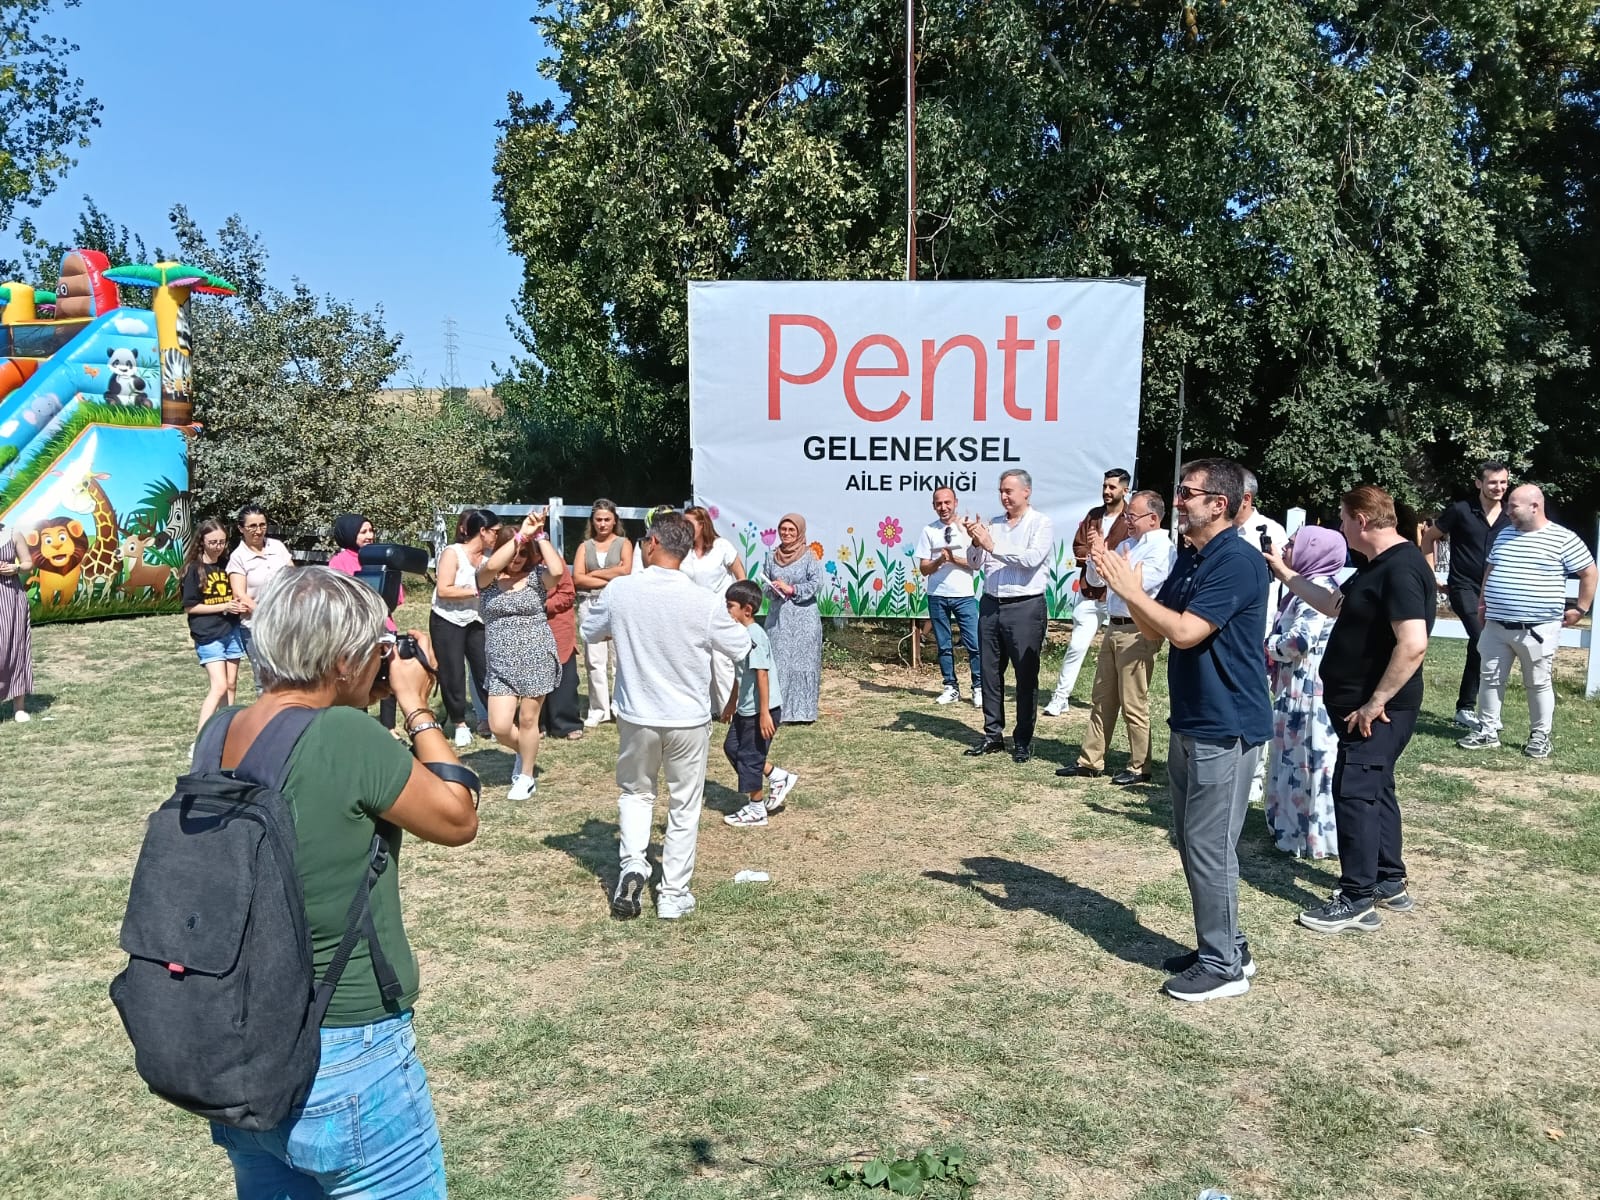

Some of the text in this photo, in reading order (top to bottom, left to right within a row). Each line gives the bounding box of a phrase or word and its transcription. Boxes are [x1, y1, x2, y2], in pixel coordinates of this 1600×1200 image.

[769, 314, 1061, 422] Penti
[804, 436, 1021, 462] GELENEKSEL
[845, 470, 977, 492] AİLE PİKNİĞİ
